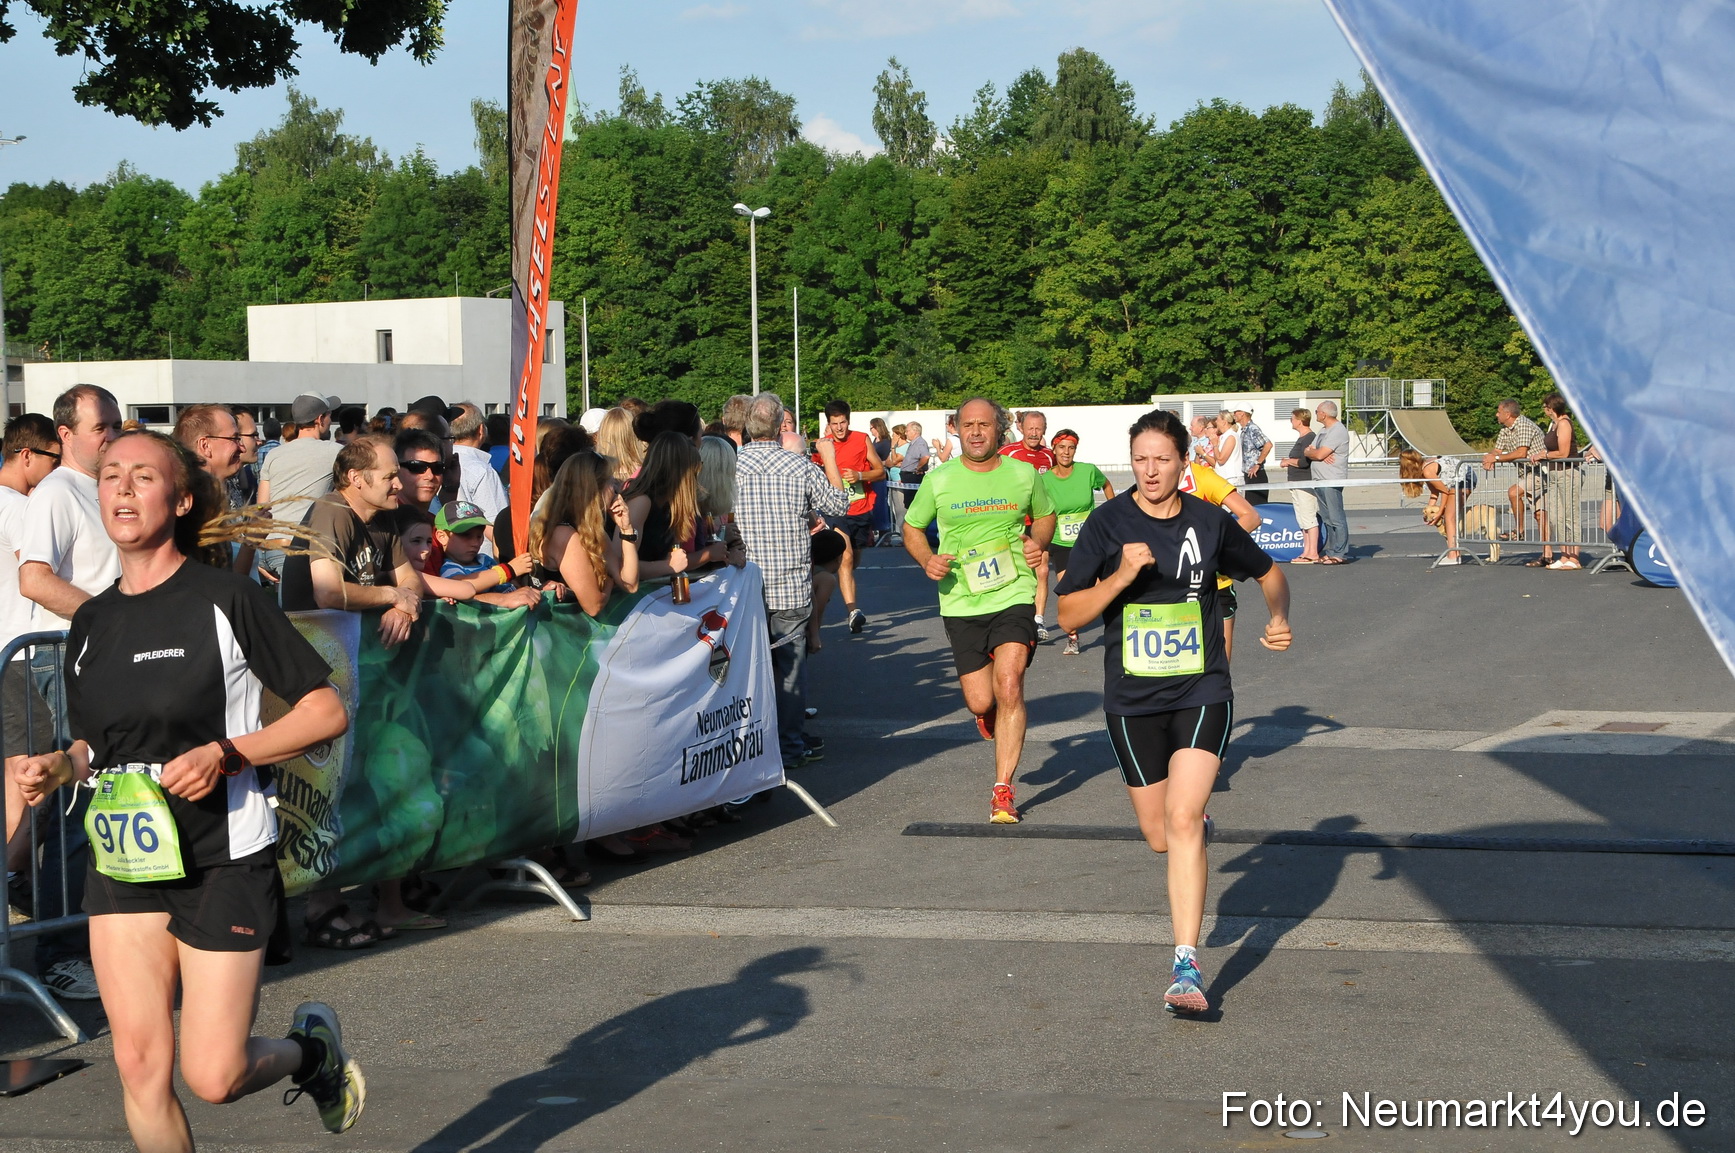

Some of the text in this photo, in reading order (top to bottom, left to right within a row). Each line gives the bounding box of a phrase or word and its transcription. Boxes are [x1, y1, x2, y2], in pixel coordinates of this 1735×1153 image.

[950, 497, 1008, 510] autoladen
[965, 502, 1019, 514] neumarkt
[1258, 542, 1305, 550] UTOMOBIL
[977, 557, 1001, 579] 41
[1126, 627, 1201, 659] 1054
[140, 648, 185, 661] PFLEIDERER
[695, 695, 753, 738] Neumarkter
[679, 722, 764, 786] Lammsbräu
[94, 811, 159, 854] 976
